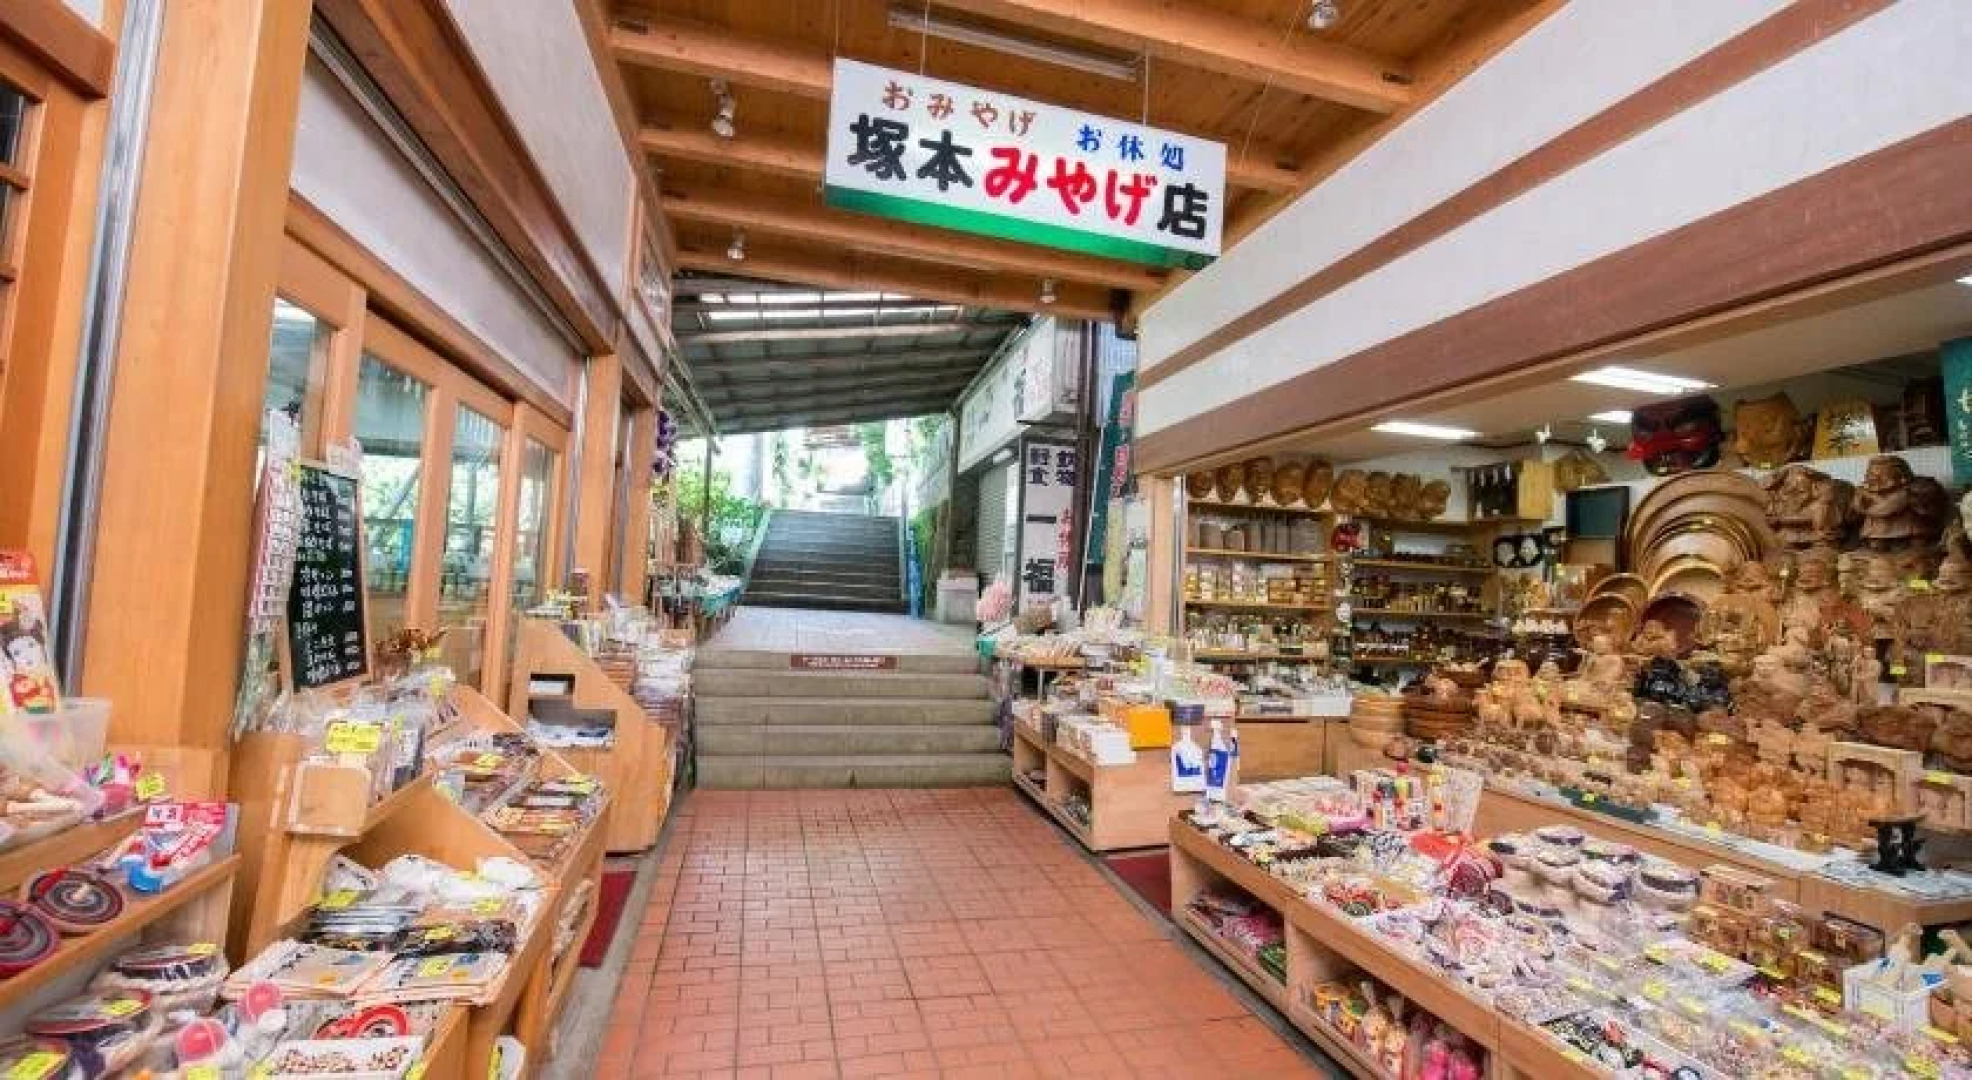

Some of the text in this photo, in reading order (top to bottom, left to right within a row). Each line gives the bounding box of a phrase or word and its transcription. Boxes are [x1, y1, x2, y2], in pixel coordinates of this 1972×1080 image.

[883, 80, 1036, 136] おみやげ
[1076, 124, 1185, 171] お休処
[847, 113, 1208, 239] 塚本みやげ店
